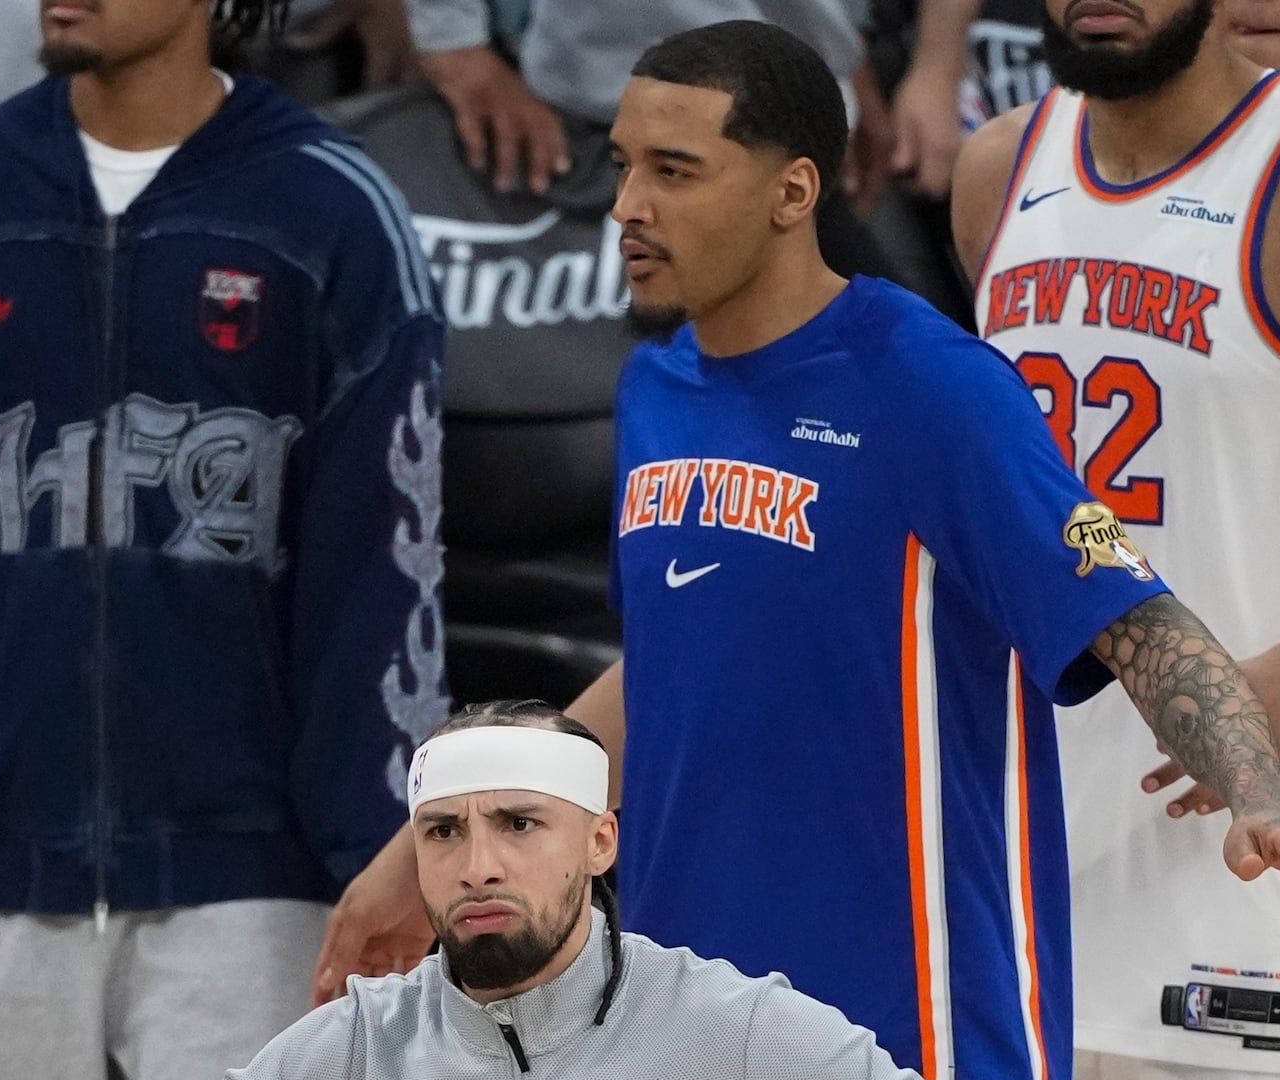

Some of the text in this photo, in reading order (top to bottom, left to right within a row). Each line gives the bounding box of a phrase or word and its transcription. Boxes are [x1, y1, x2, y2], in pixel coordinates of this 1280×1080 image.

[1160, 203, 1237, 224] abu dhabi
[411, 207, 632, 331] Final
[984, 257, 1221, 358] NEW YORK
[791, 425, 861, 448] abu dhabi
[619, 457, 820, 552] NEW YORK
[1067, 515, 1127, 574] Final
